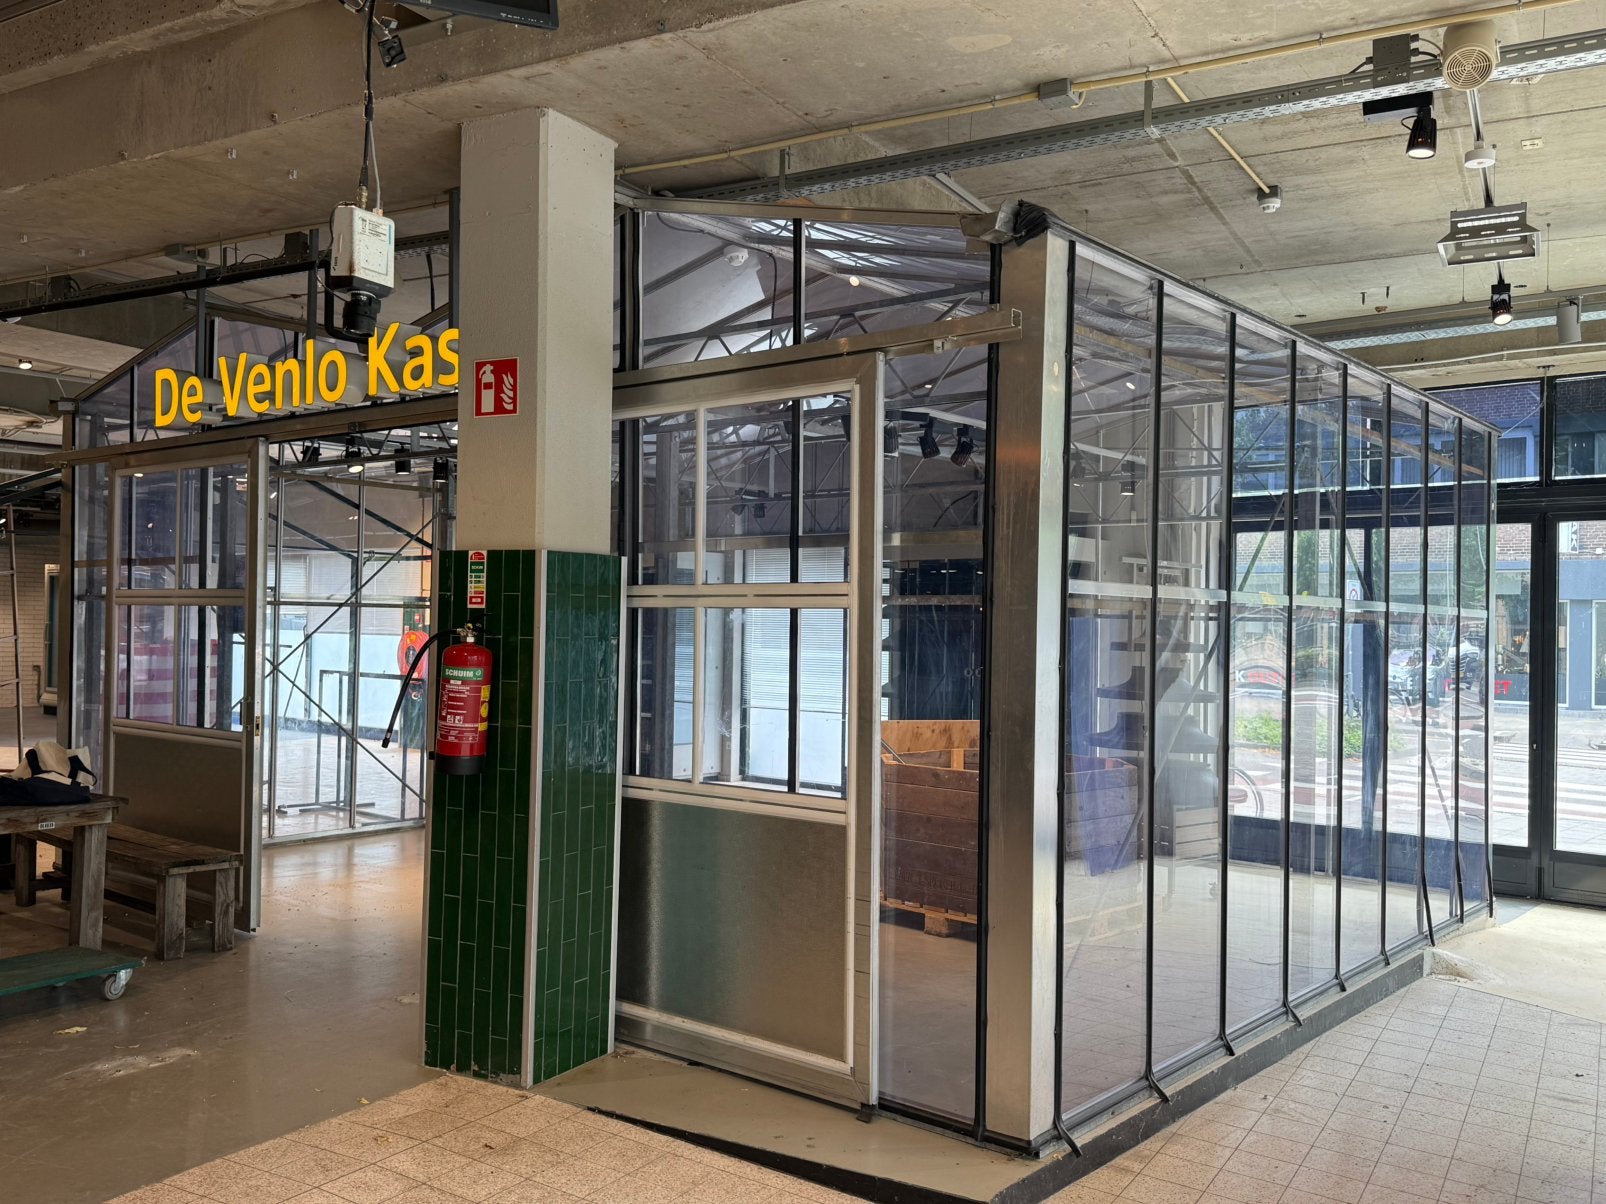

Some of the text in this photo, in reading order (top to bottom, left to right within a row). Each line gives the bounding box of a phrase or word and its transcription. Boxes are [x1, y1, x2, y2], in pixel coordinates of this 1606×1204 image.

[155, 322, 459, 427] De Venlo Kas
[445, 668, 474, 678] SCHUIM
